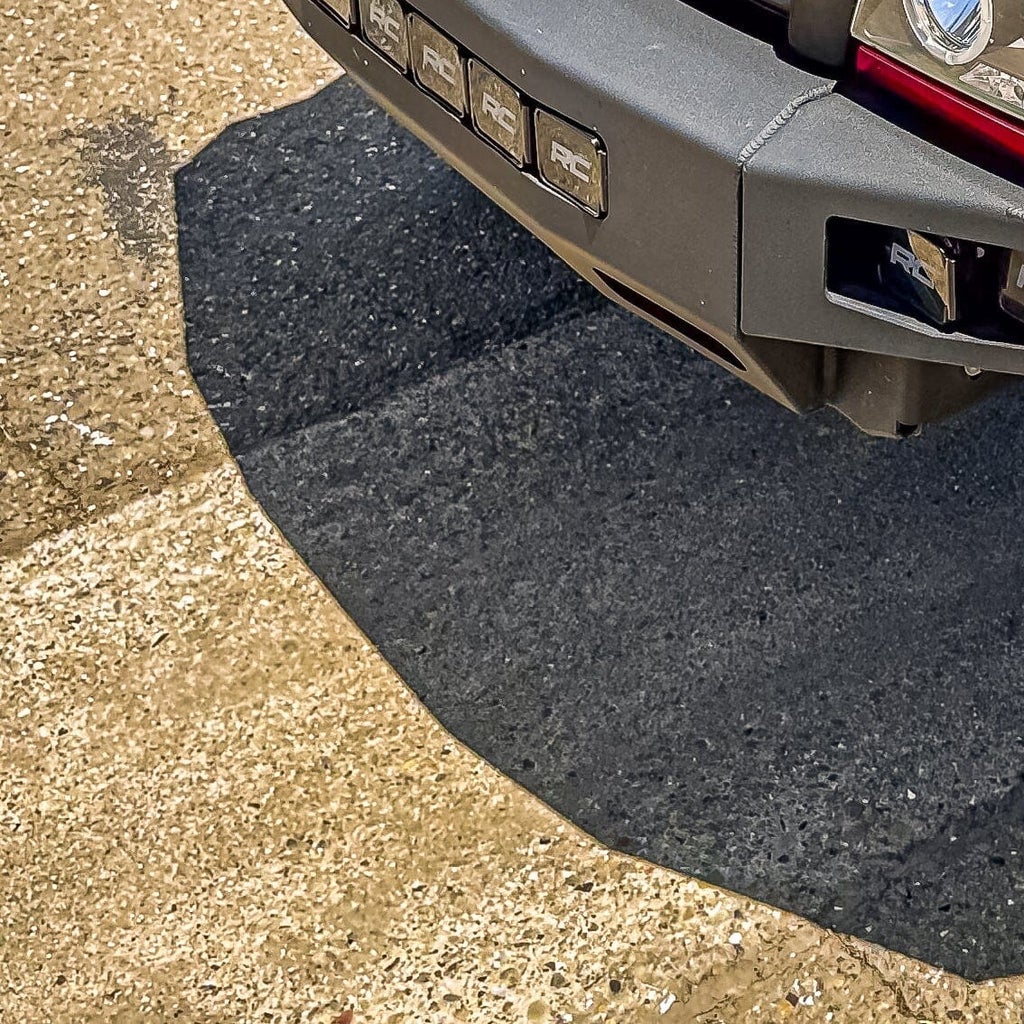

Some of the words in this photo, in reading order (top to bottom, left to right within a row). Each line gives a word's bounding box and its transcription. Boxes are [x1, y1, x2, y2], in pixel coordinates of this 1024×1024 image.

[422, 45, 457, 86] RC
[481, 91, 517, 137] RC
[550, 140, 593, 183] RC
[889, 242, 937, 290] RC
